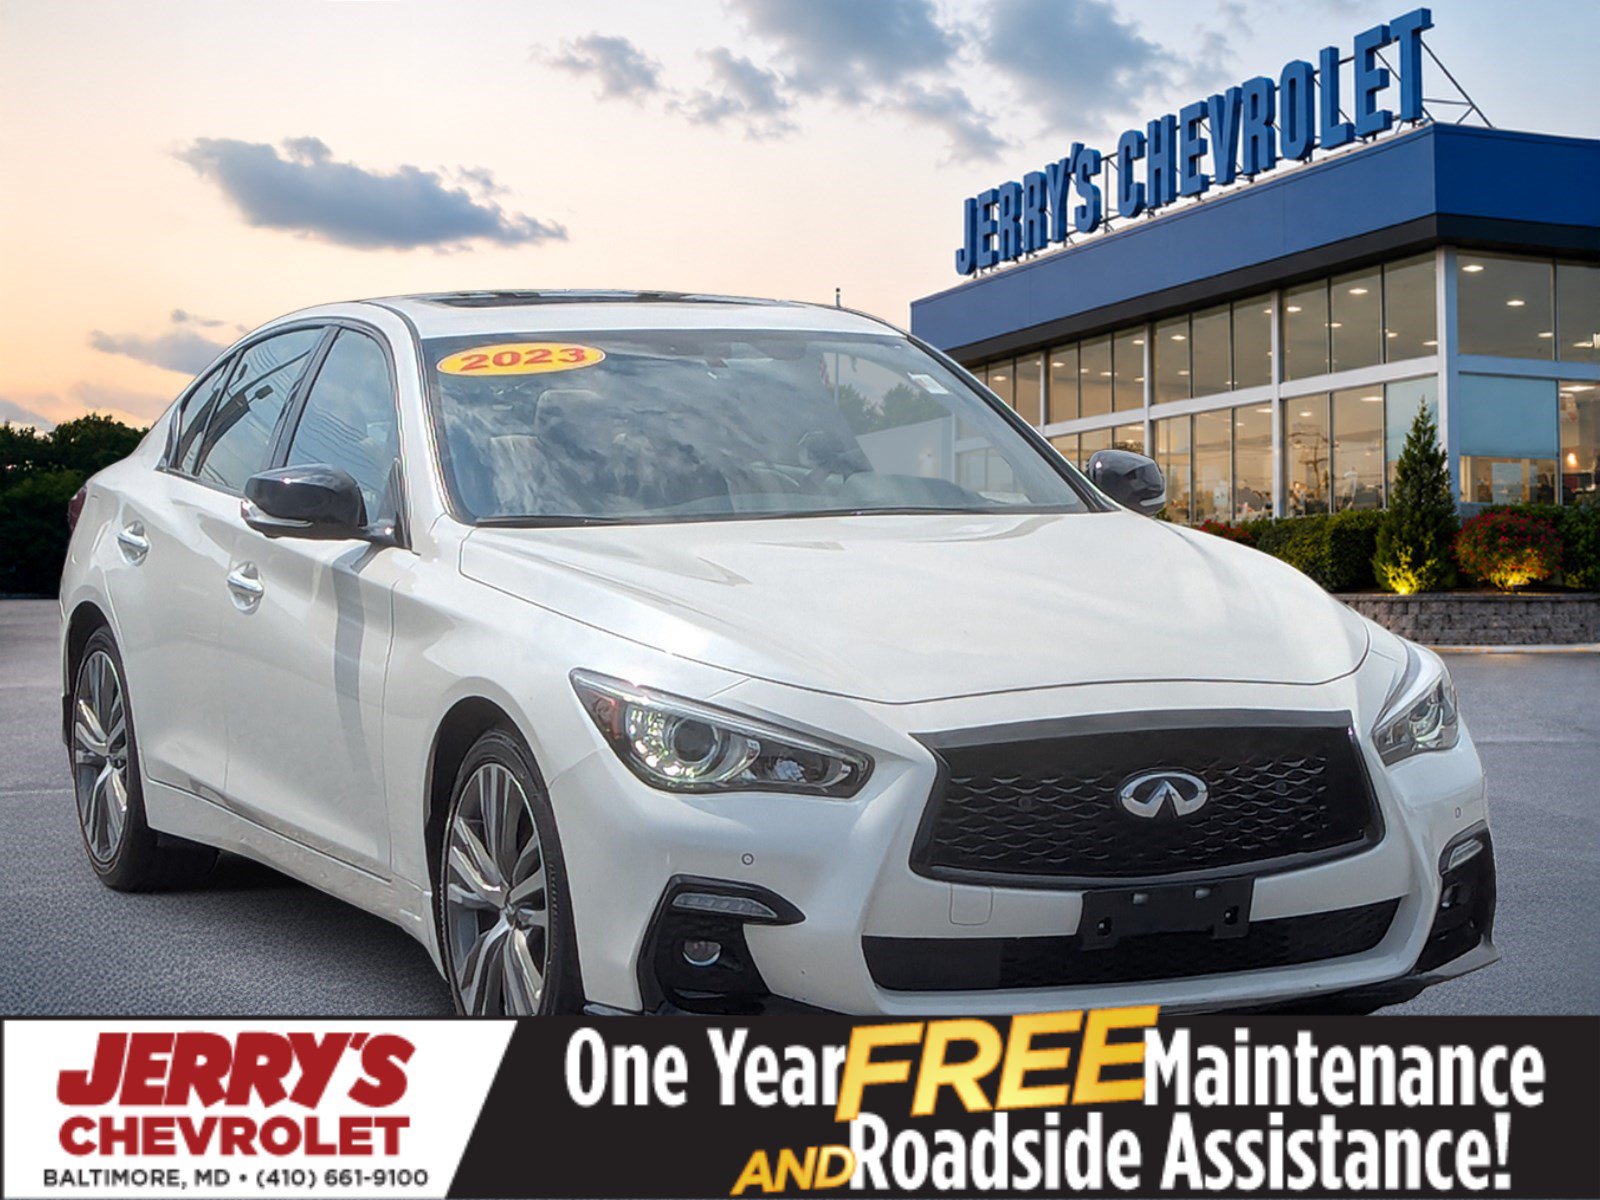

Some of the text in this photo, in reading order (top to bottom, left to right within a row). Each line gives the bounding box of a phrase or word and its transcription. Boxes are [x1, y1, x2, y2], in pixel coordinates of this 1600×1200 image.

[956, 8, 1434, 275] JERRY'S CHEVROLET
[460, 348, 587, 372] 2023
